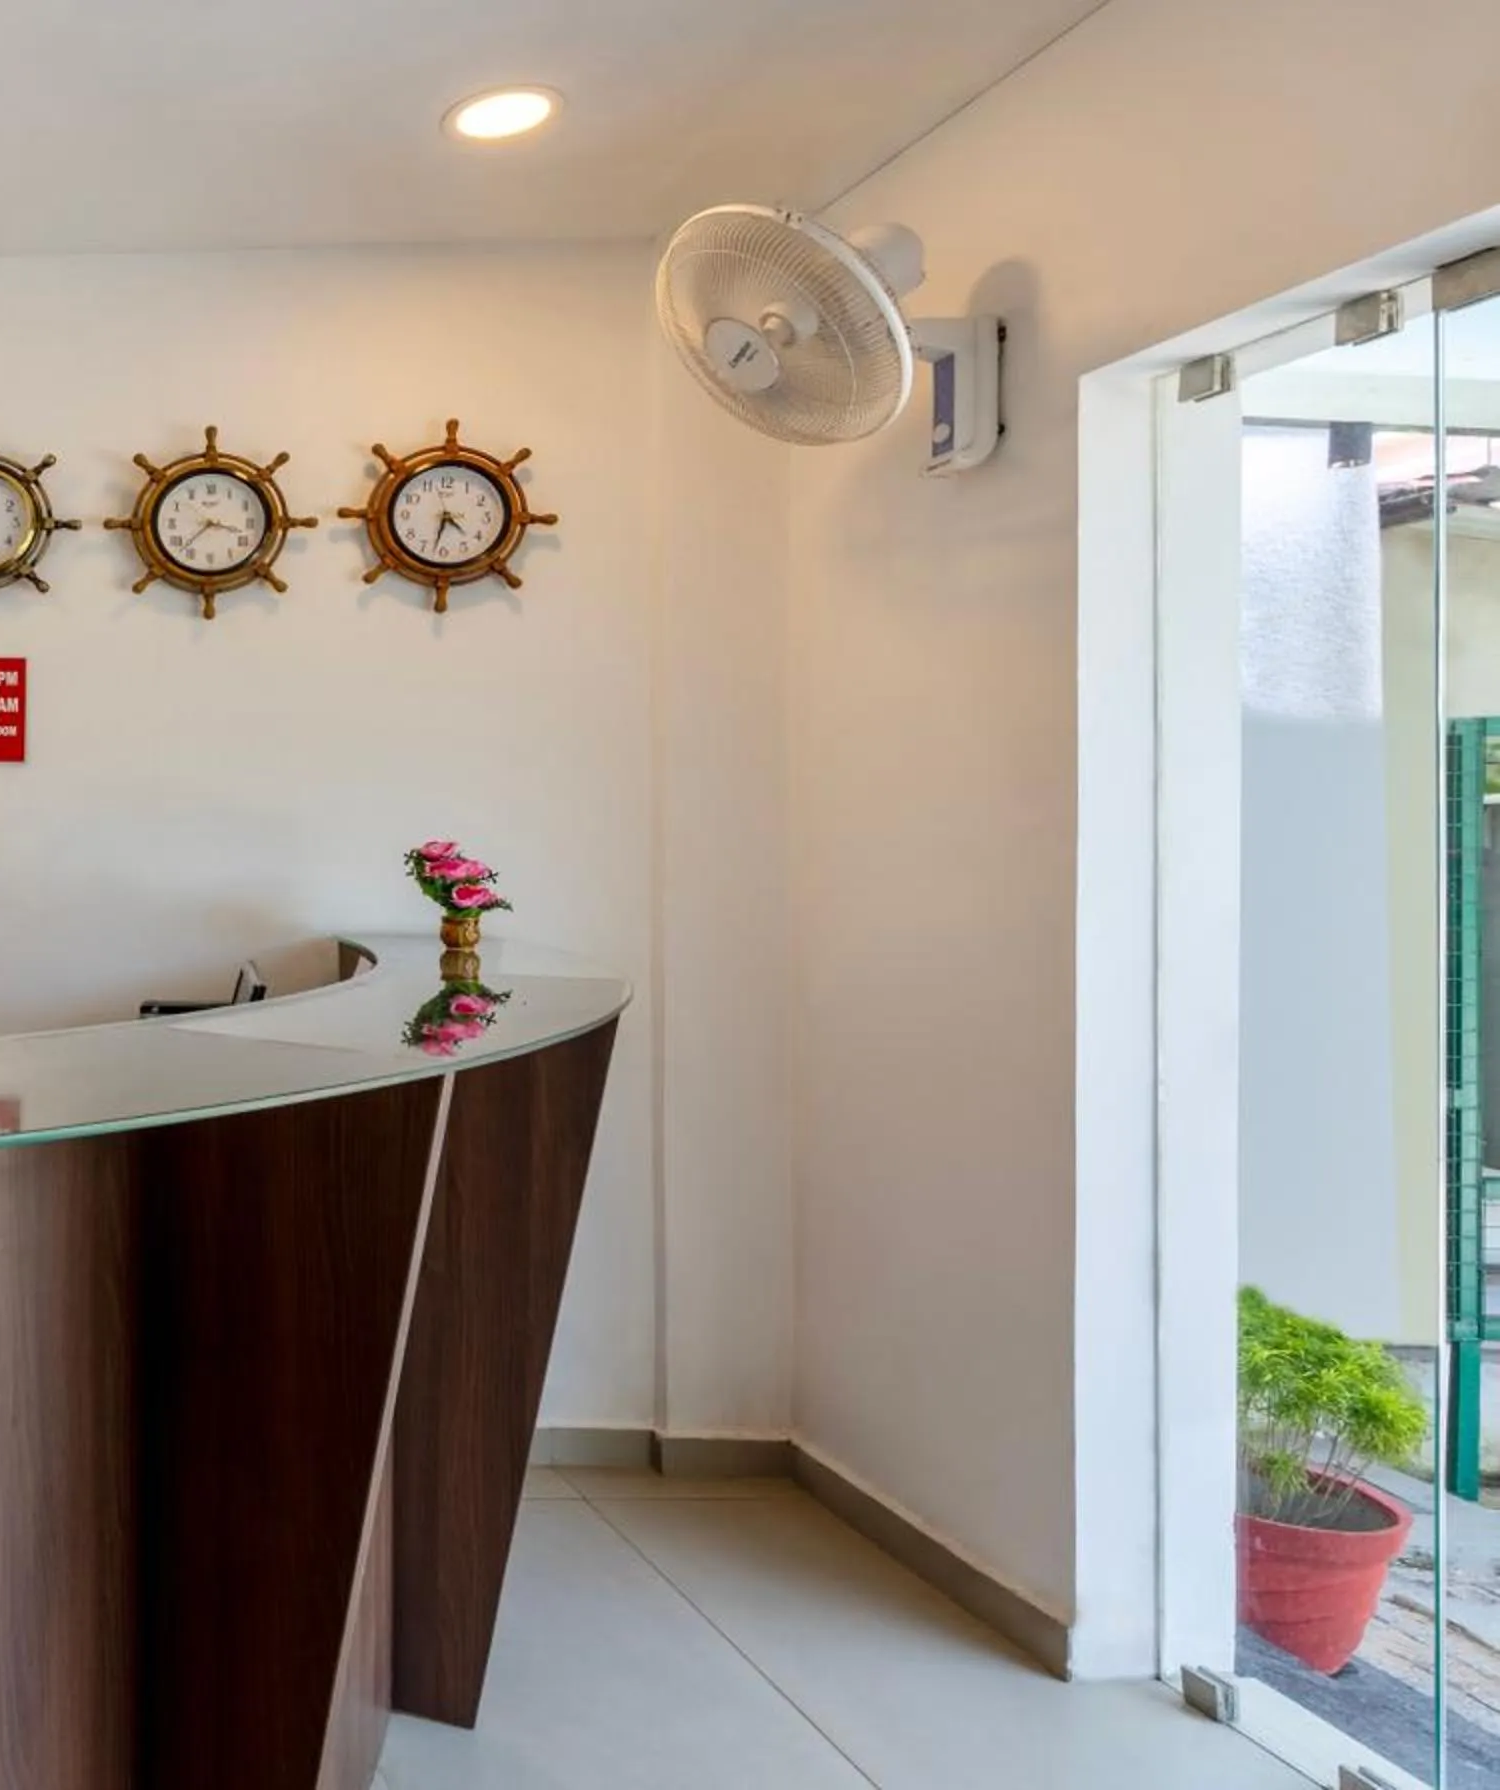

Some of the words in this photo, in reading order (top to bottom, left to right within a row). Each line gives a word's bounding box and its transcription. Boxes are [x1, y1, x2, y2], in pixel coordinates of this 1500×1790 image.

[423, 480, 433, 492] 11
[441, 476, 455, 488] 12
[466, 482, 469, 493] 1
[406, 495, 420, 504] 10
[476, 495, 485, 506] 2
[6, 501, 14, 512] 2
[401, 510, 410, 520] 9
[484, 512, 490, 523] 3
[13, 518, 20, 527] 3
[406, 530, 415, 540] 8
[474, 531, 481, 541] 4
[5, 536, 12, 545] 4
[420, 540, 427, 552] 7
[460, 542, 468, 552] 5
[439, 548, 449, 557] 6
